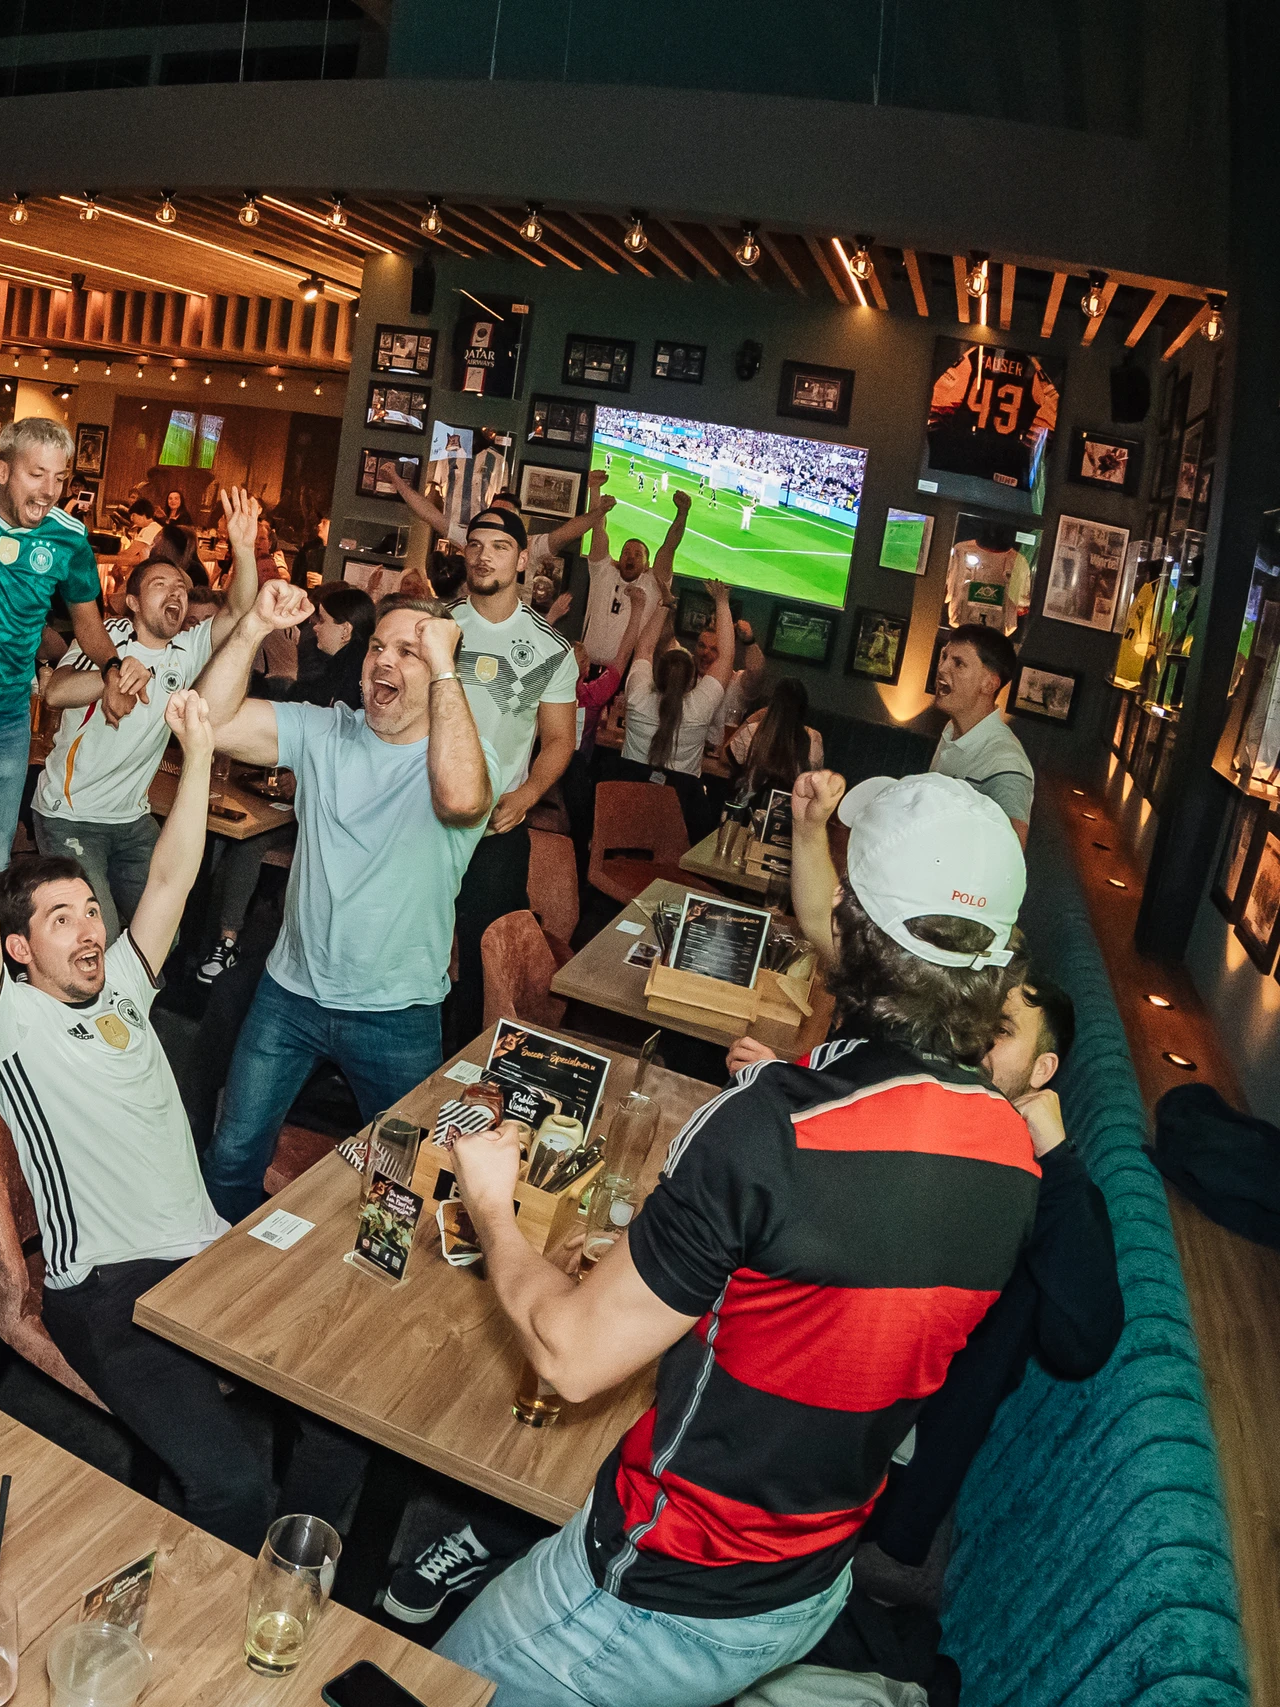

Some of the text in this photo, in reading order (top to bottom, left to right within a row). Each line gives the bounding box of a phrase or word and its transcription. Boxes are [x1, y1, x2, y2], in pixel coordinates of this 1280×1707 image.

[967, 378, 1024, 435] 43
[974, 586, 999, 598] AOK
[951, 889, 987, 908] POLO
